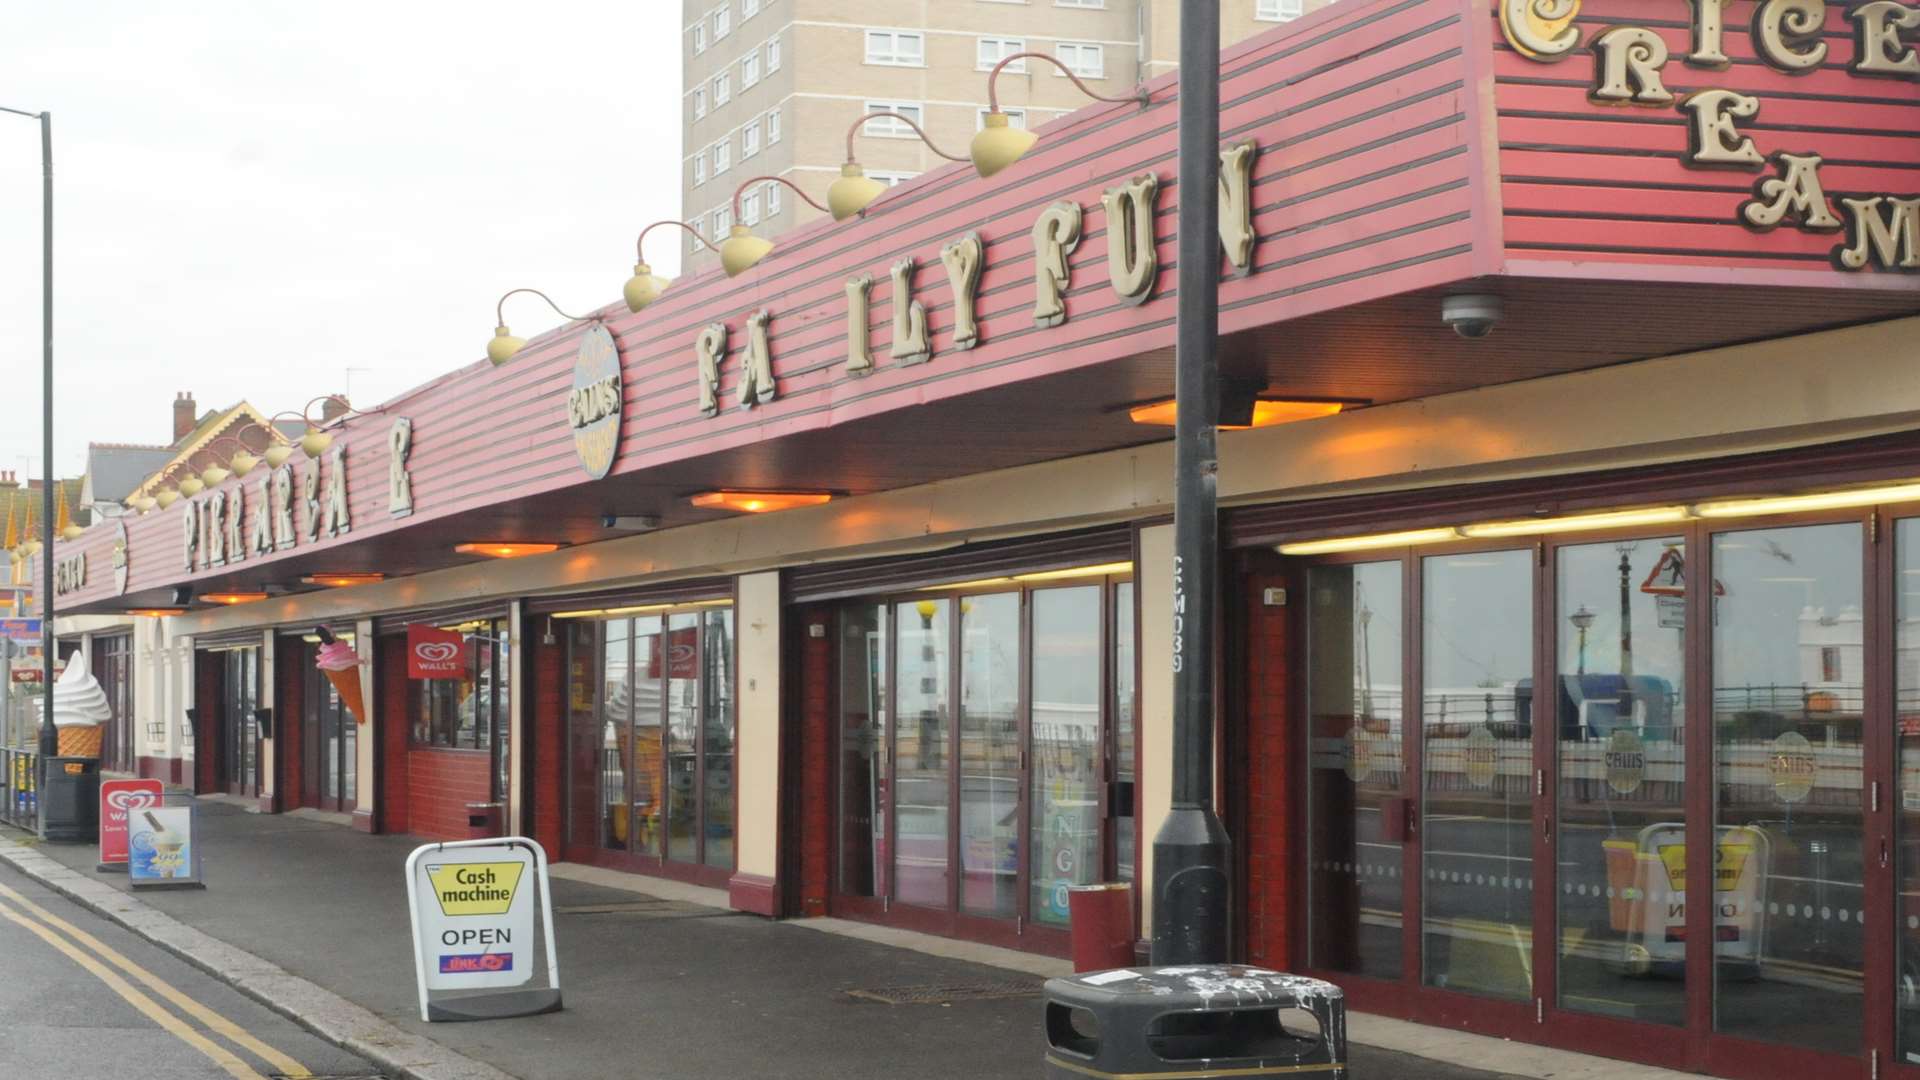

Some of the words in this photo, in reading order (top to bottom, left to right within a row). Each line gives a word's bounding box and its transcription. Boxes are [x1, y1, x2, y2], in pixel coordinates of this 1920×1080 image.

[184, 483, 246, 575] PIER
[417, 661, 456, 671] WALL'S
[456, 868, 496, 884] Cash
[443, 886, 510, 902] machine
[441, 928, 512, 946] OPEN
